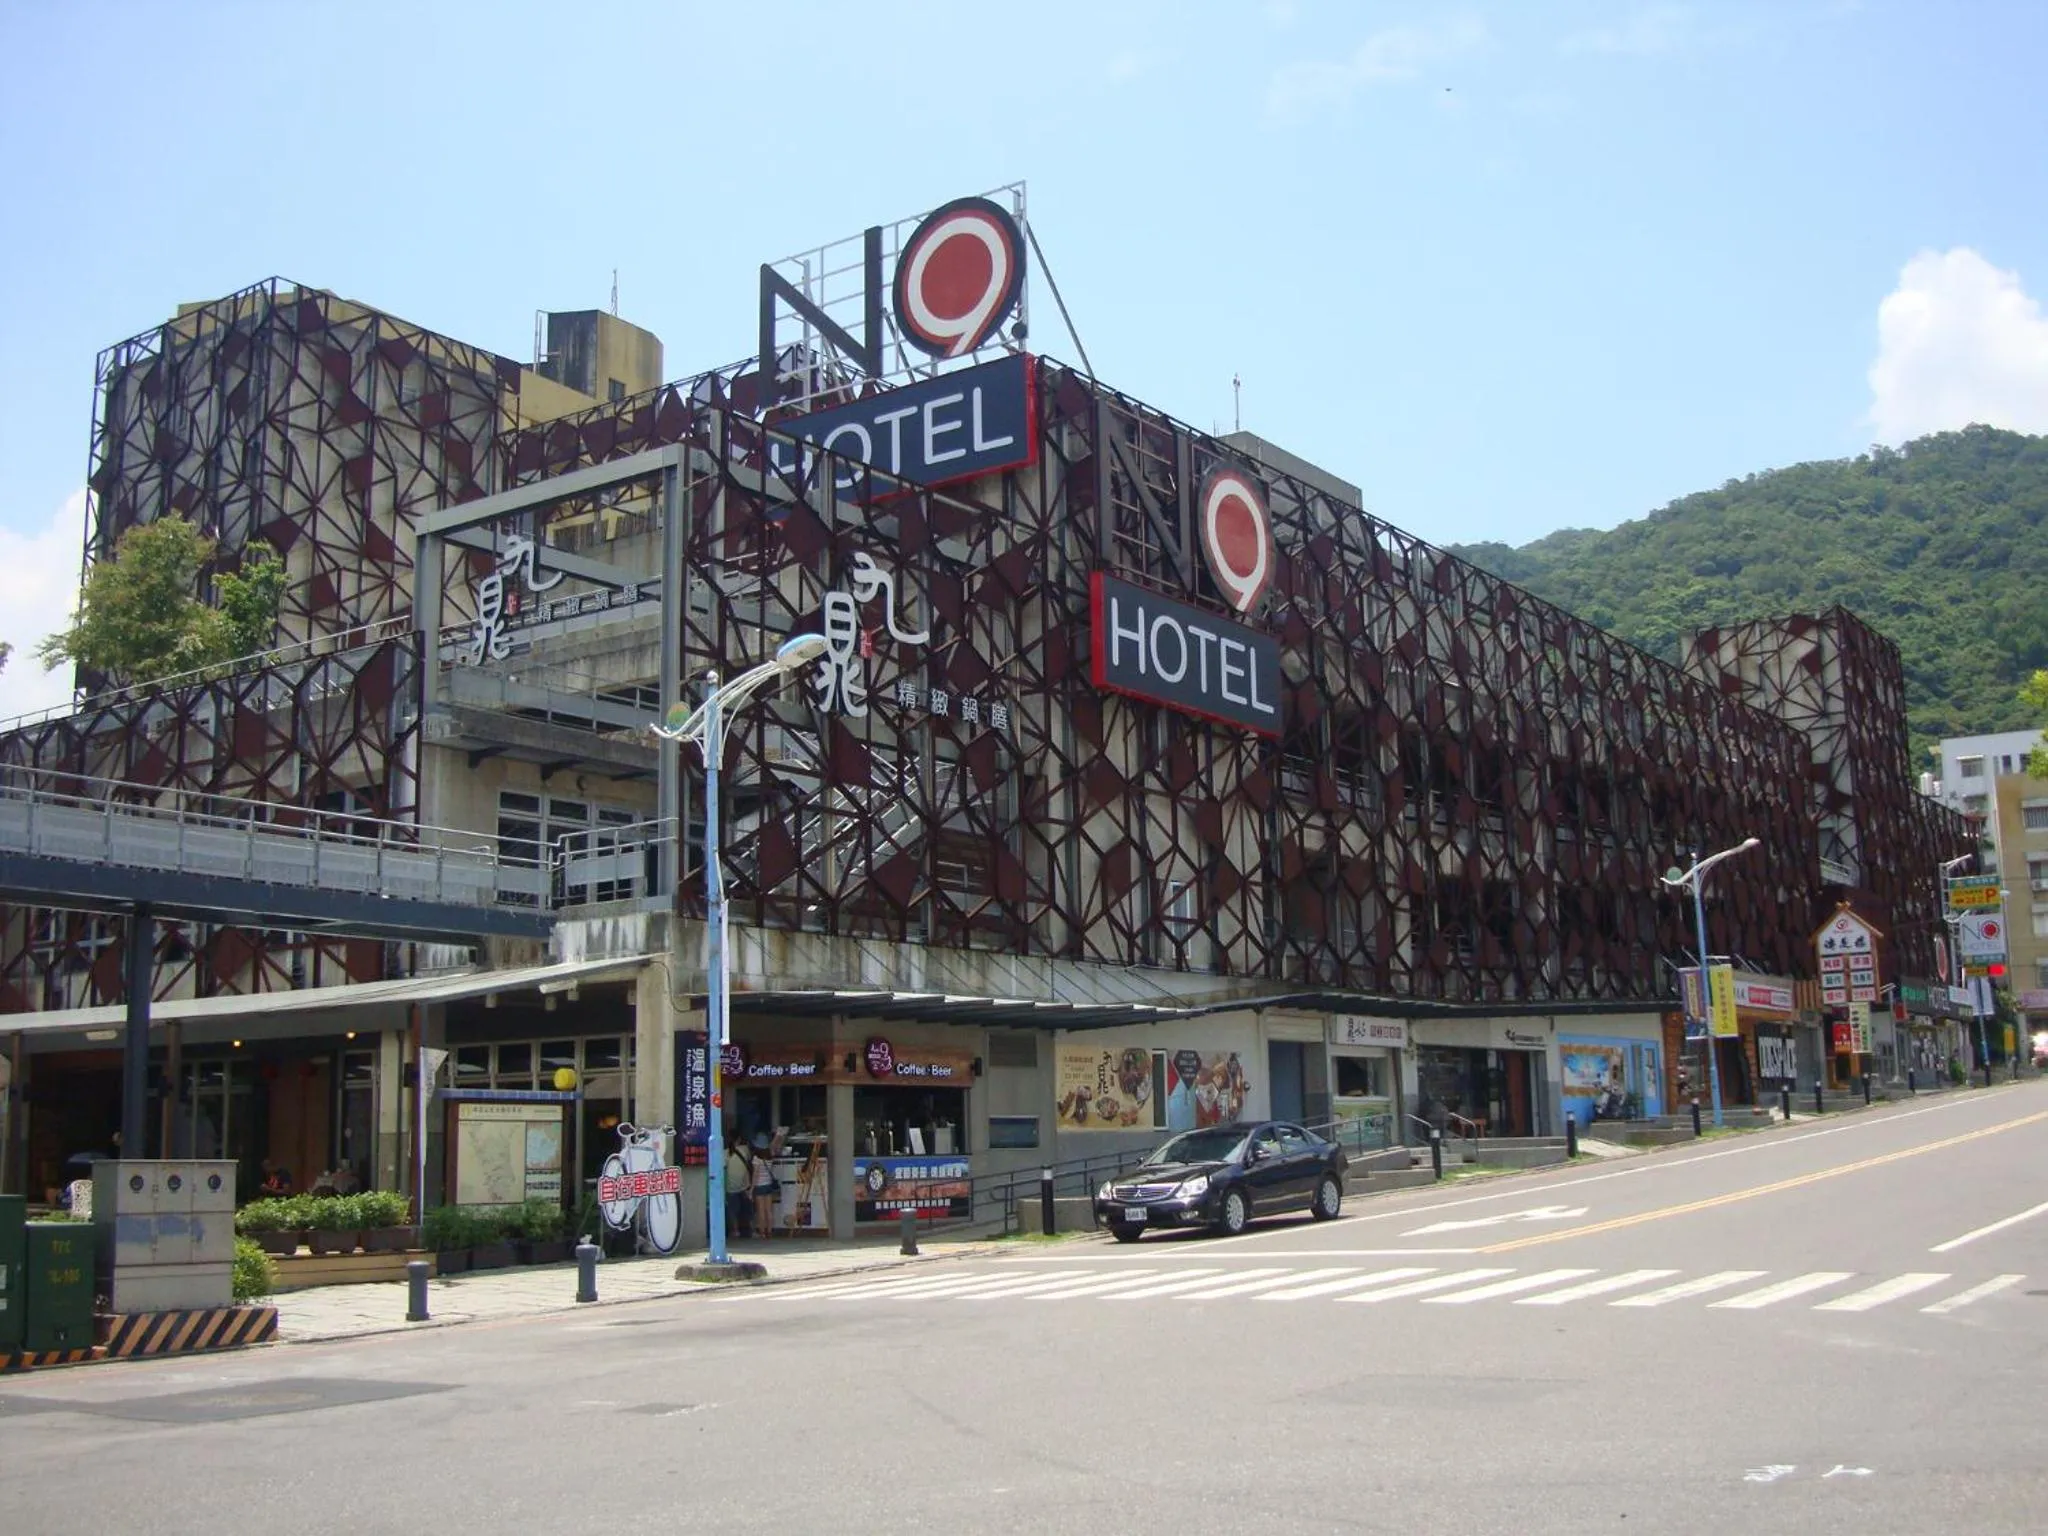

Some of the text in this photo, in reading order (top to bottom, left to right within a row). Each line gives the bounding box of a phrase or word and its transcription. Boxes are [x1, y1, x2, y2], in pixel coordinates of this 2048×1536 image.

[769, 386, 1014, 493] HOTEL
[1111, 597, 1275, 714] HOTEL
[748, 1063, 816, 1077] Coffee Beer
[896, 1062, 953, 1077] Coffee Beer
[599, 1168, 681, 1202] 自行車出租
